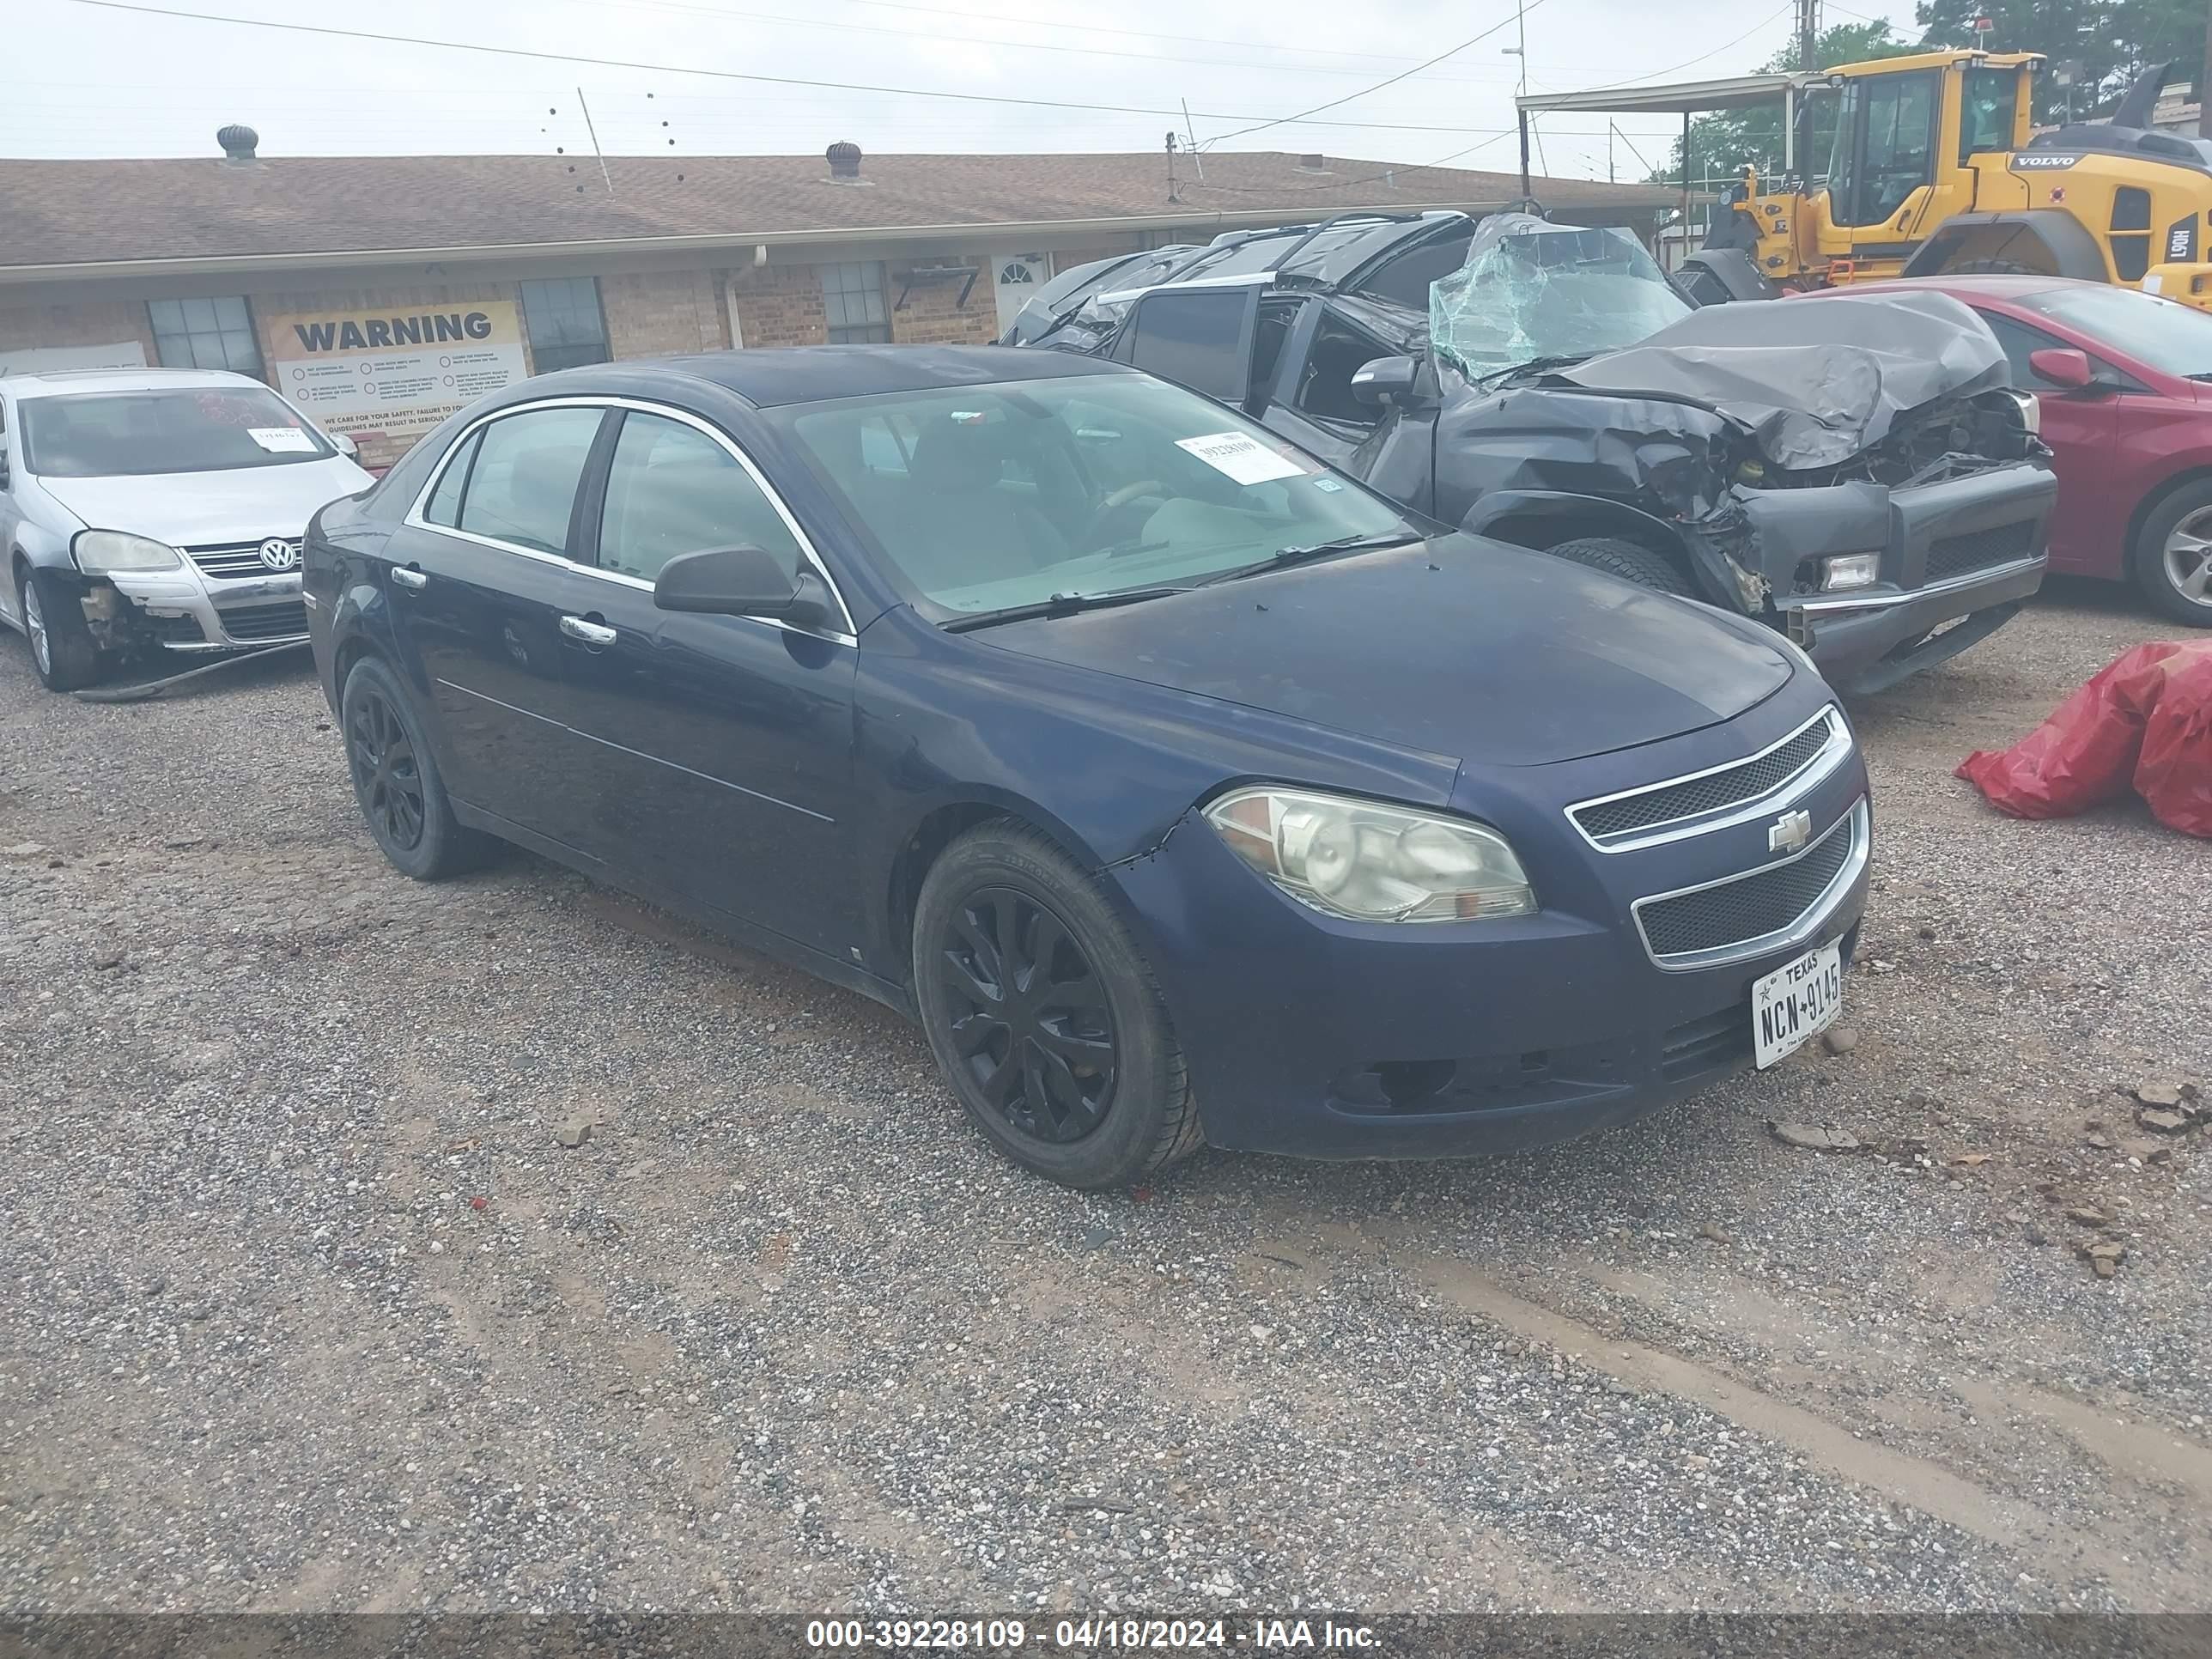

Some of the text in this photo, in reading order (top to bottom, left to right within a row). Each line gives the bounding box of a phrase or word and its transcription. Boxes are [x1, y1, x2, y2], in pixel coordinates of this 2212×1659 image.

[2018, 157, 2075, 166] VOLVO
[2171, 230, 2190, 257] L90H
[294, 312, 491, 352] WARNING
[329, 424, 367, 433] GUIDELINES
[1786, 952, 1818, 985] TEXAS
